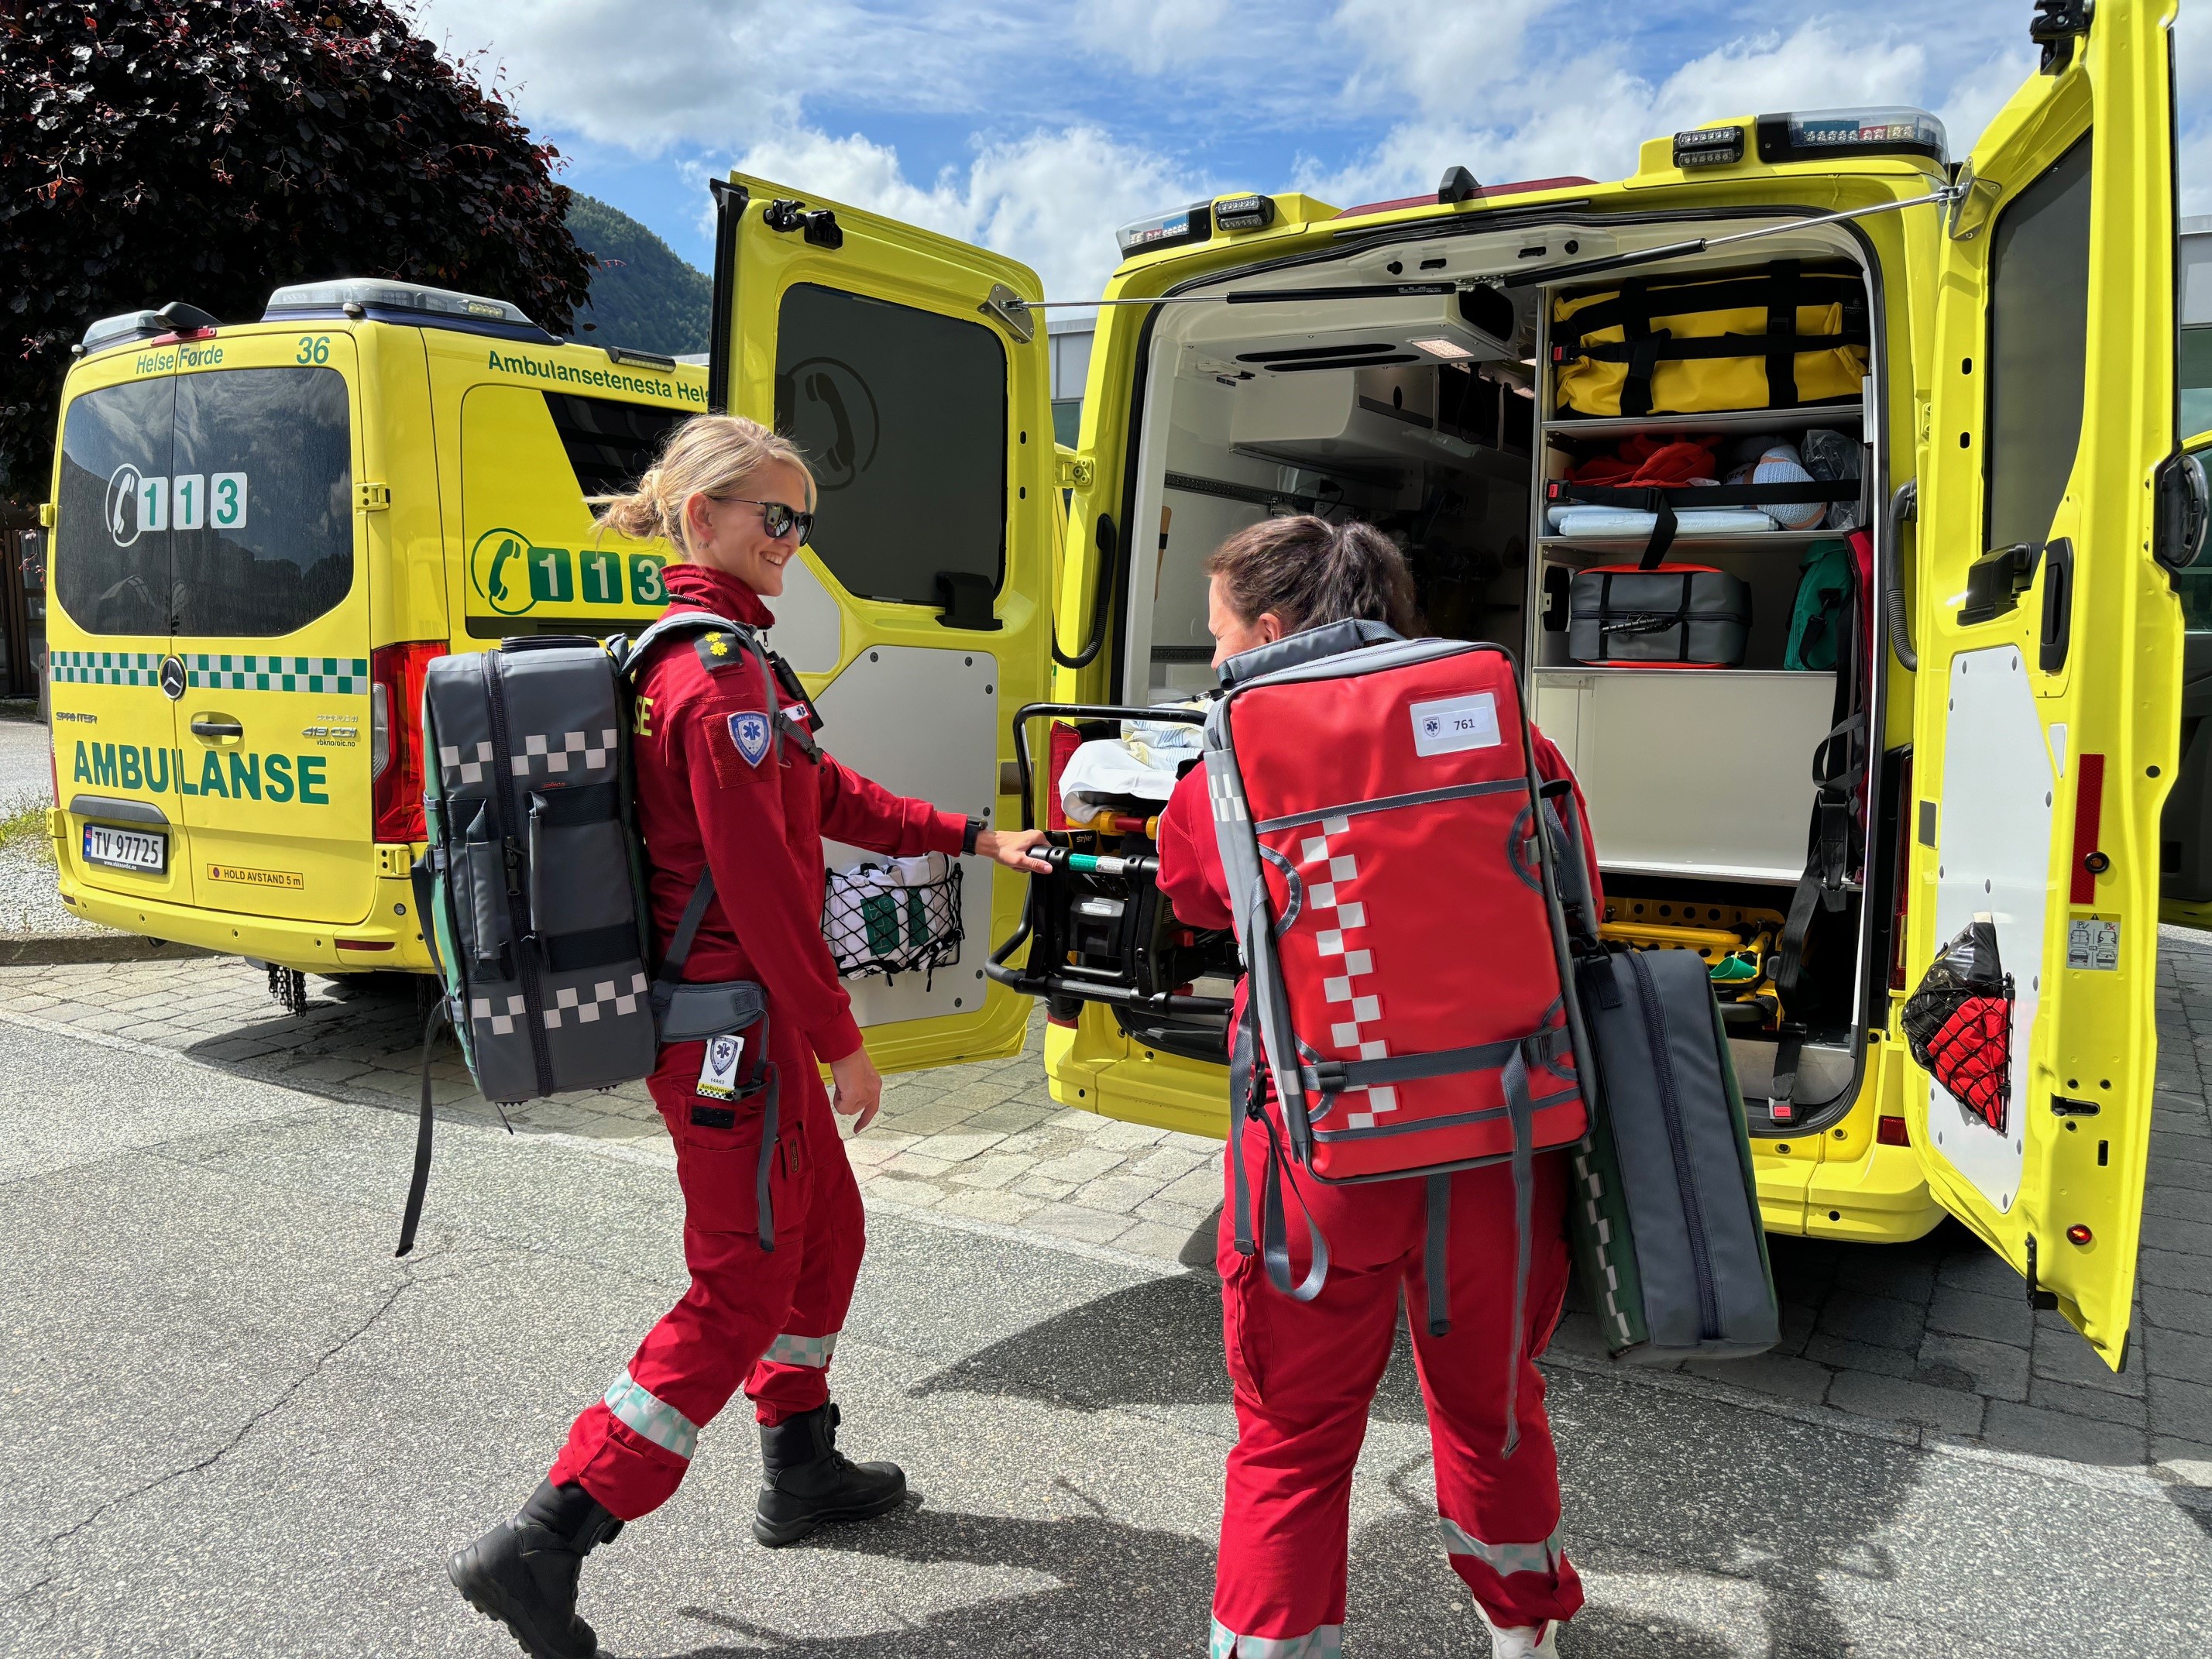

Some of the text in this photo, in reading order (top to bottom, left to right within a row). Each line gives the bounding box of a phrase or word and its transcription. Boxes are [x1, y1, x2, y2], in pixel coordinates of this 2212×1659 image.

[136, 345, 224, 375] Helse Førde
[296, 336, 331, 365] 36
[488, 350, 673, 399] Ambulansetenesta
[144, 479, 239, 527] 113
[539, 553, 661, 601] 113
[1453, 719, 1475, 730] 761
[74, 740, 329, 805] AMBULANSE
[94, 831, 159, 864] TV 97725
[224, 869, 246, 880] HOLD
[247, 872, 284, 884] AVSTAND
[287, 876, 291, 885] 5
